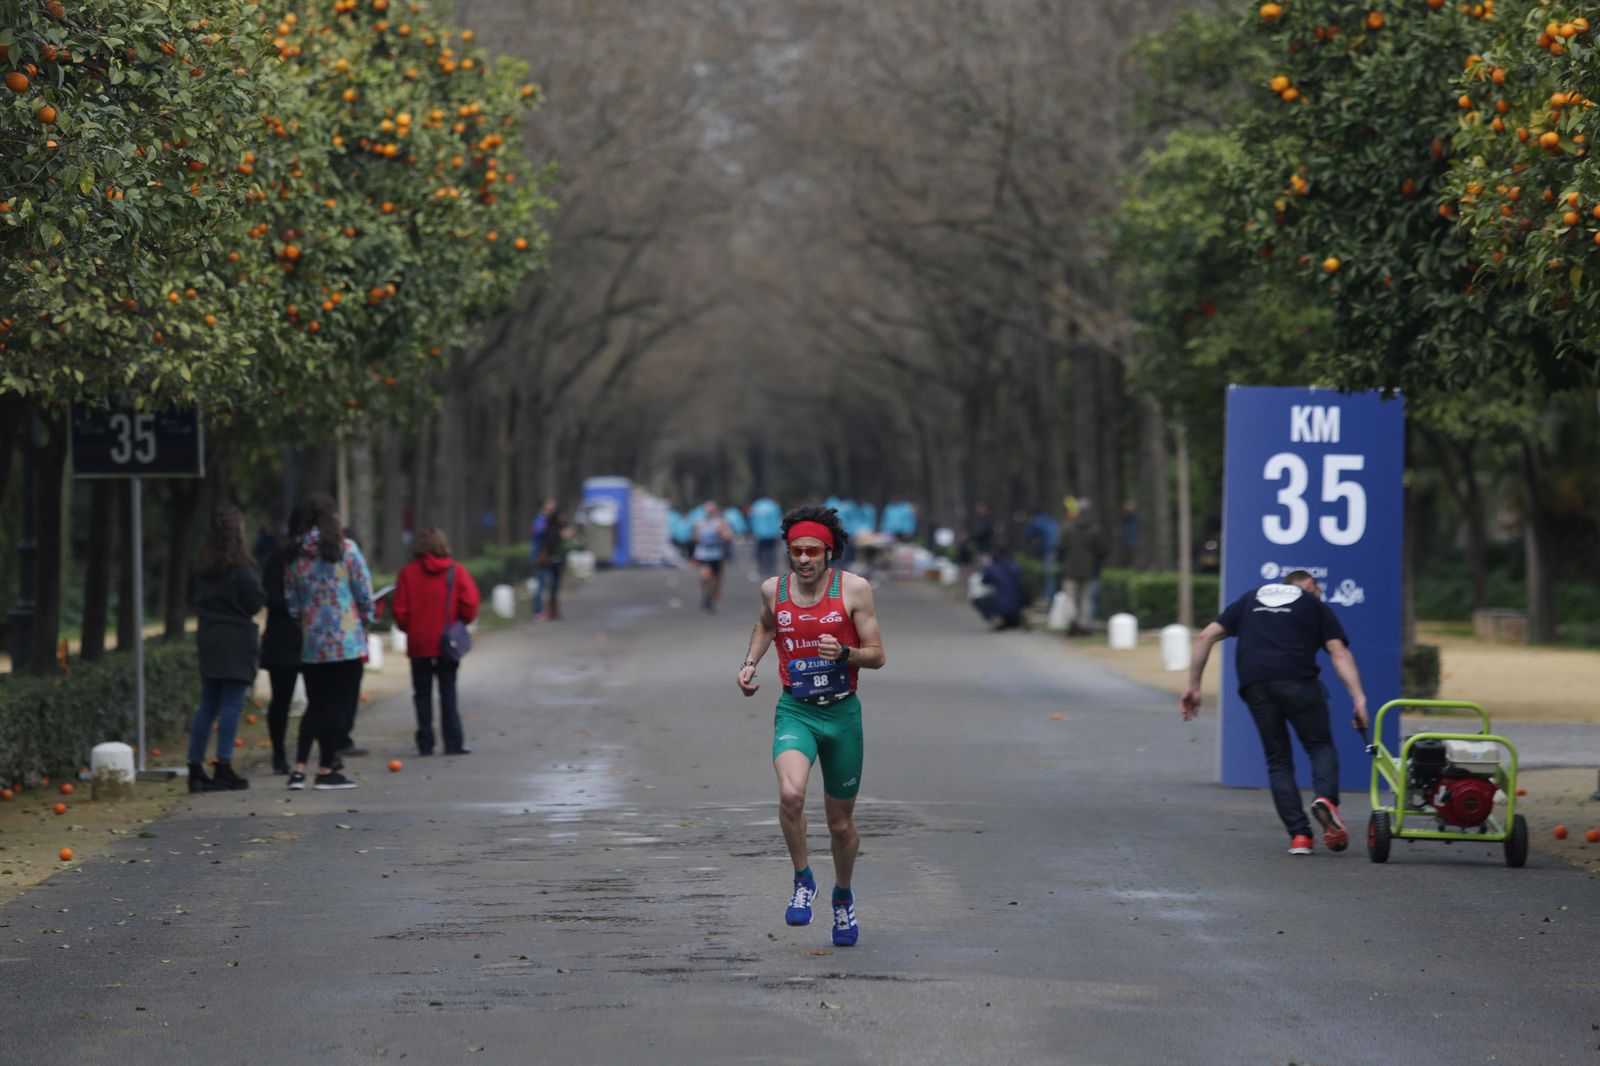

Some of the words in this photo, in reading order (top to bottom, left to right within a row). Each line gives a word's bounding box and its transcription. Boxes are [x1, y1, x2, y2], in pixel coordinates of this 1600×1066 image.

[109, 413, 157, 464] 35
[1290, 405, 1341, 443] KM
[1261, 452, 1367, 546] 35
[795, 639, 821, 649] Llam
[813, 674, 829, 687] 88
